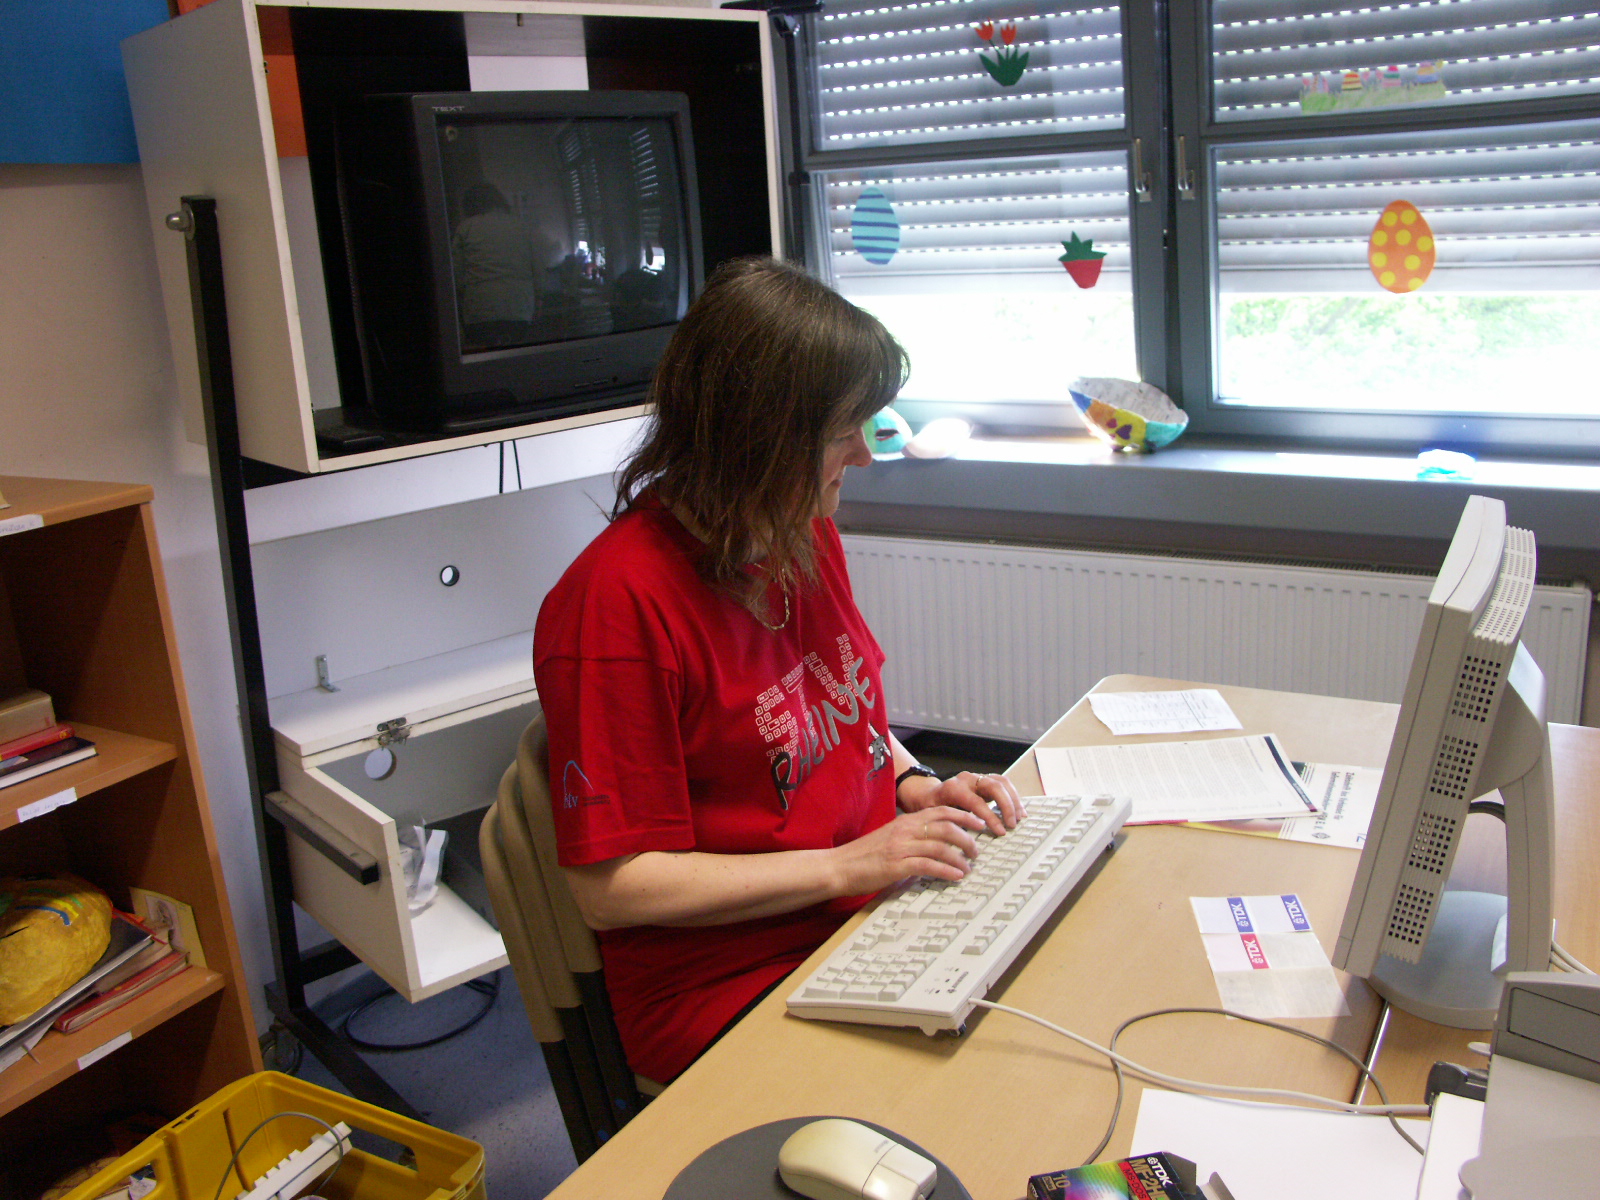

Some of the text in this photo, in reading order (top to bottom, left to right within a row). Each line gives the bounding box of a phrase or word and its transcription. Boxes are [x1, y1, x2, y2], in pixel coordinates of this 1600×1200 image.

[771, 657, 876, 811] RHEINE
[1230, 903, 1247, 922] TDK
[1284, 900, 1303, 919] TDK
[1244, 940, 1262, 959] TDK
[1053, 1174, 1071, 1188] 10
[1124, 1169, 1147, 1199] MS-DOS
[1152, 1162, 1174, 1187] TDK
